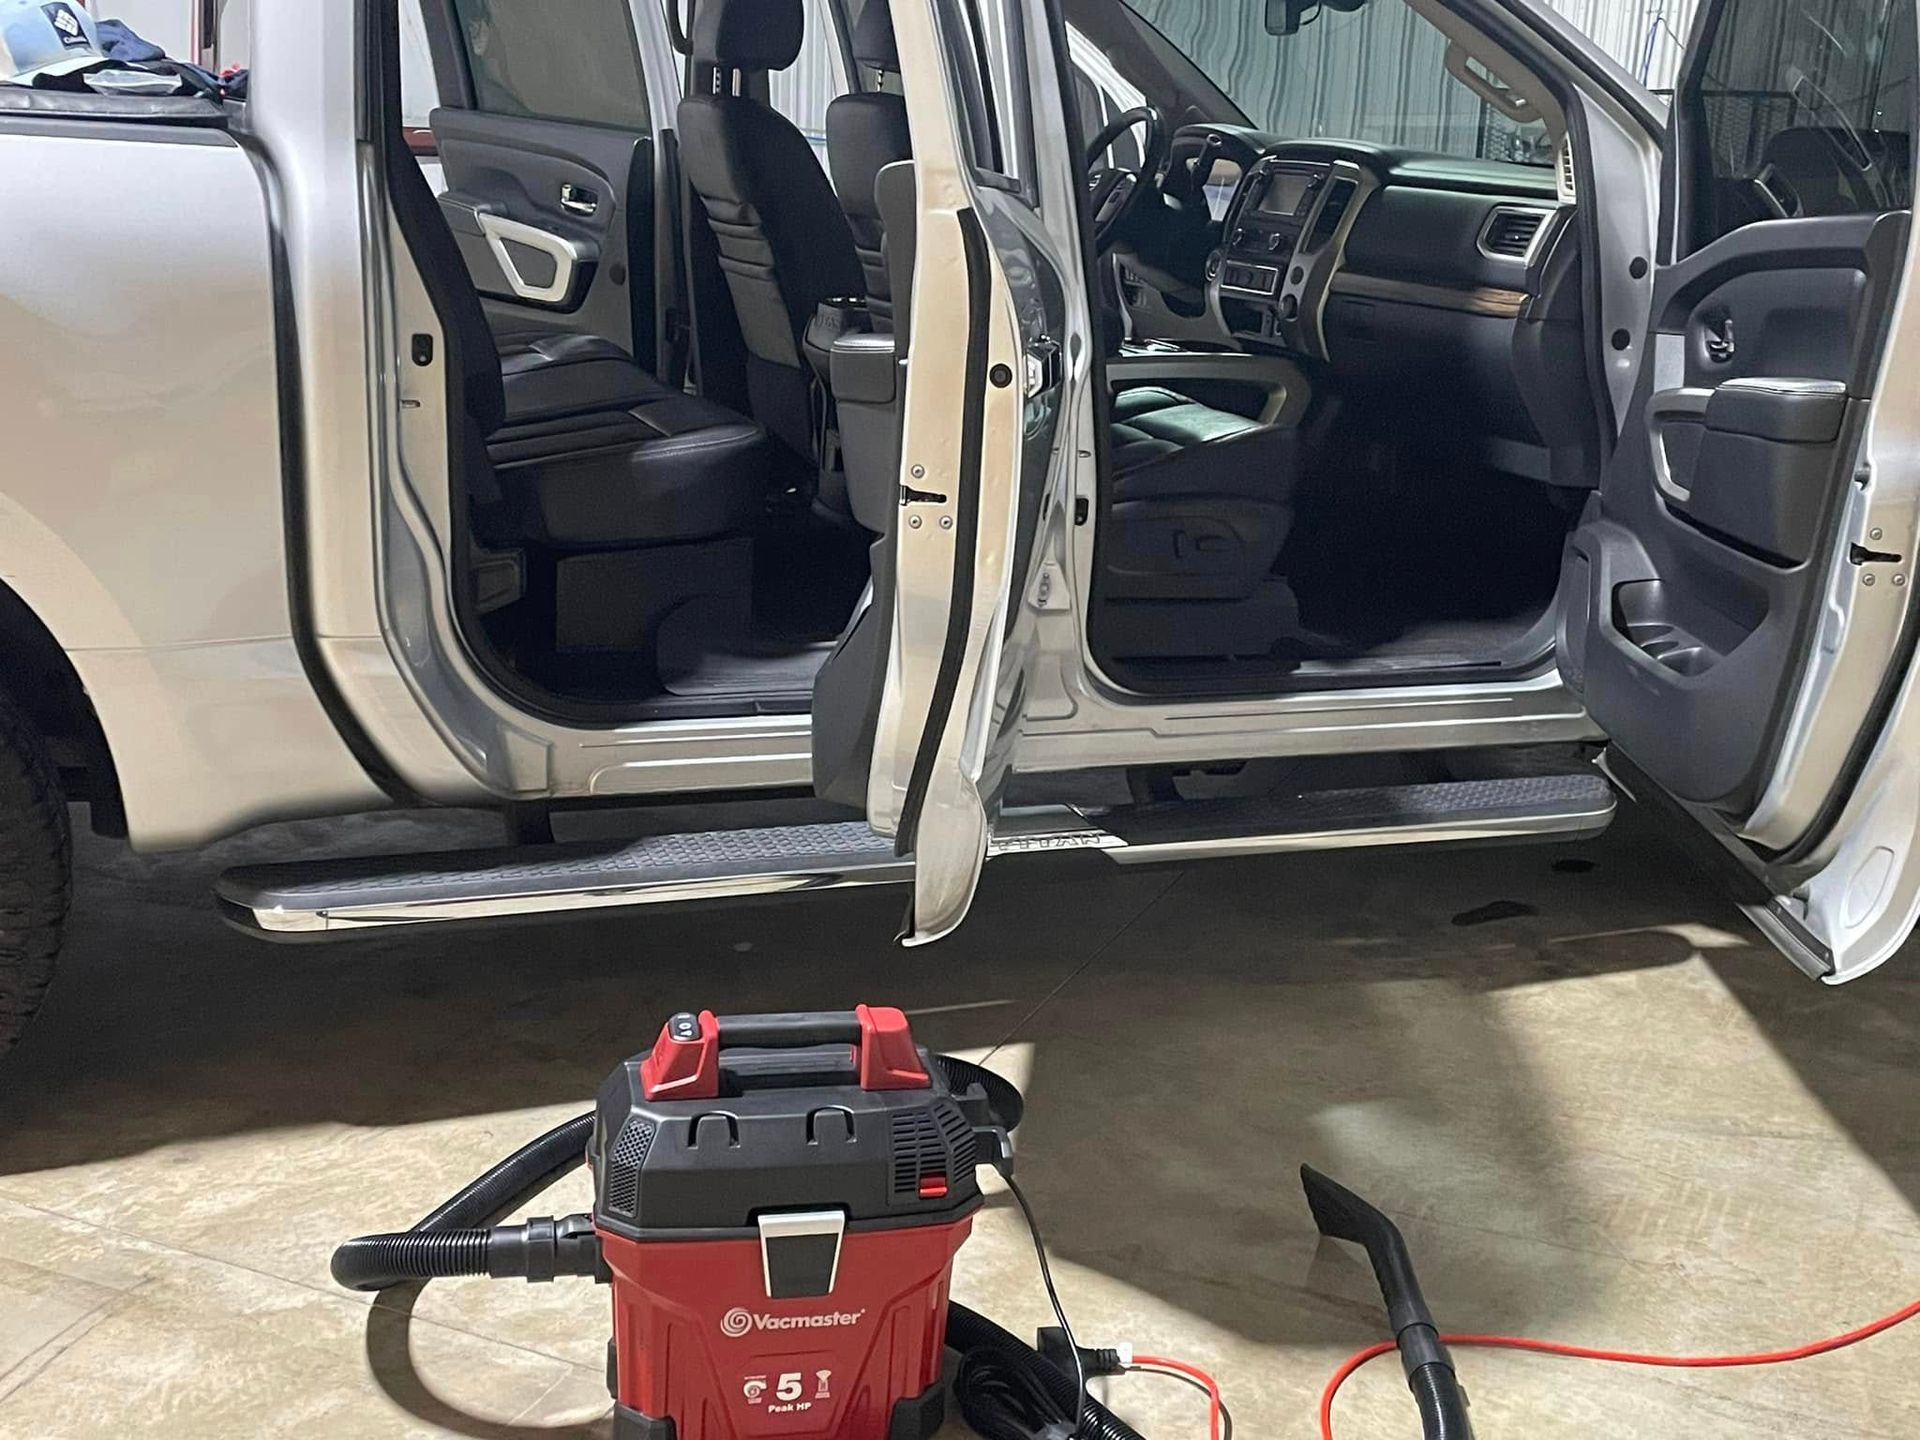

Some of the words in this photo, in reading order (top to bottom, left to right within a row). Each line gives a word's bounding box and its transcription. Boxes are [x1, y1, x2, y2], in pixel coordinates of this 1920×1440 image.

[752, 1311, 862, 1330] Vacmaster
[776, 1372, 802, 1400] 5
[768, 1403, 794, 1413] Peak
[796, 1402, 811, 1411] HP
